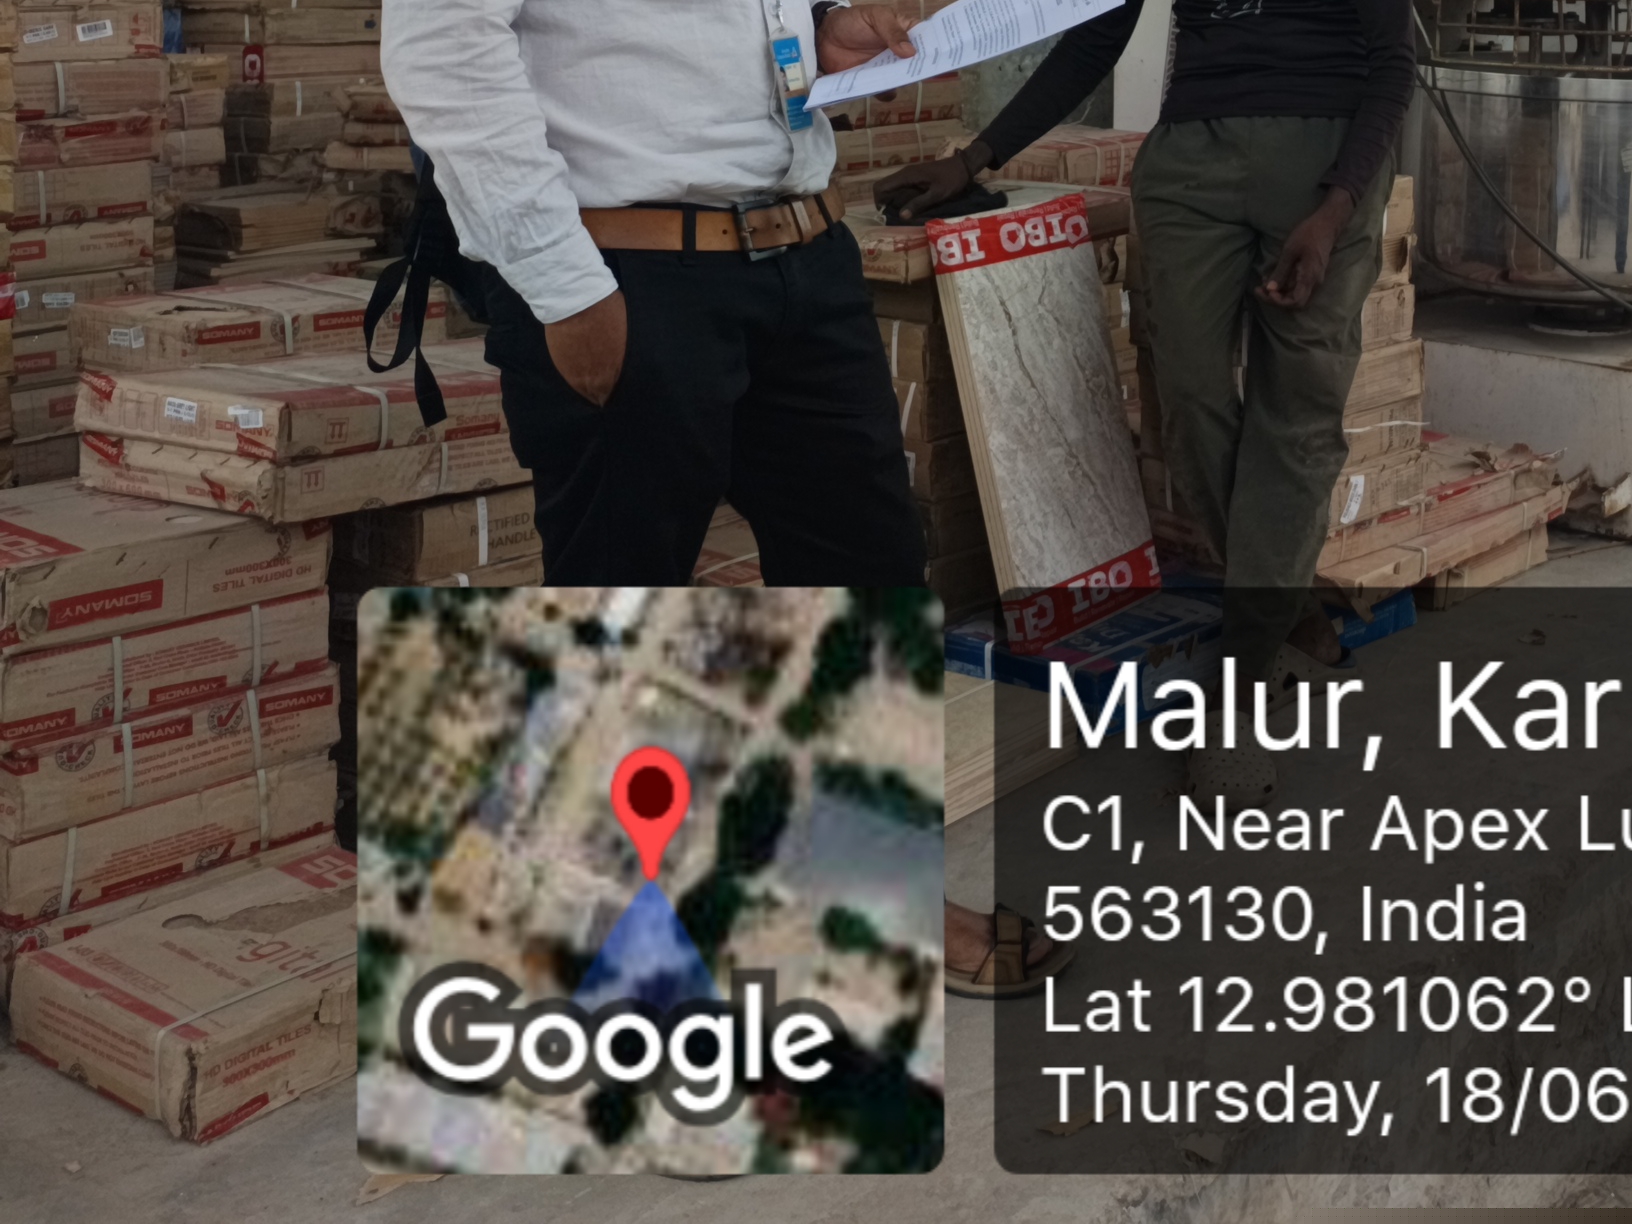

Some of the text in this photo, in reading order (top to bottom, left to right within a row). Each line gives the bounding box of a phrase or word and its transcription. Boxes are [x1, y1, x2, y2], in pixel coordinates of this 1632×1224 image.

[202, 327, 254, 340] SOMANY
[215, 419, 272, 437] SOANY
[456, 413, 500, 427] Somany
[470, 512, 530, 537] RTIFIED
[212, 564, 312, 593] HD DIGITAL TILES
[1067, 560, 1133, 614] IBO
[60, 590, 152, 618] SOMANY
[156, 683, 221, 701] SOMANY
[265, 693, 327, 711] SOMANY
[120, 723, 186, 743] OMANY
[225, 1041, 274, 1070] DIGITAL
[276, 1024, 313, 1046] TILES
